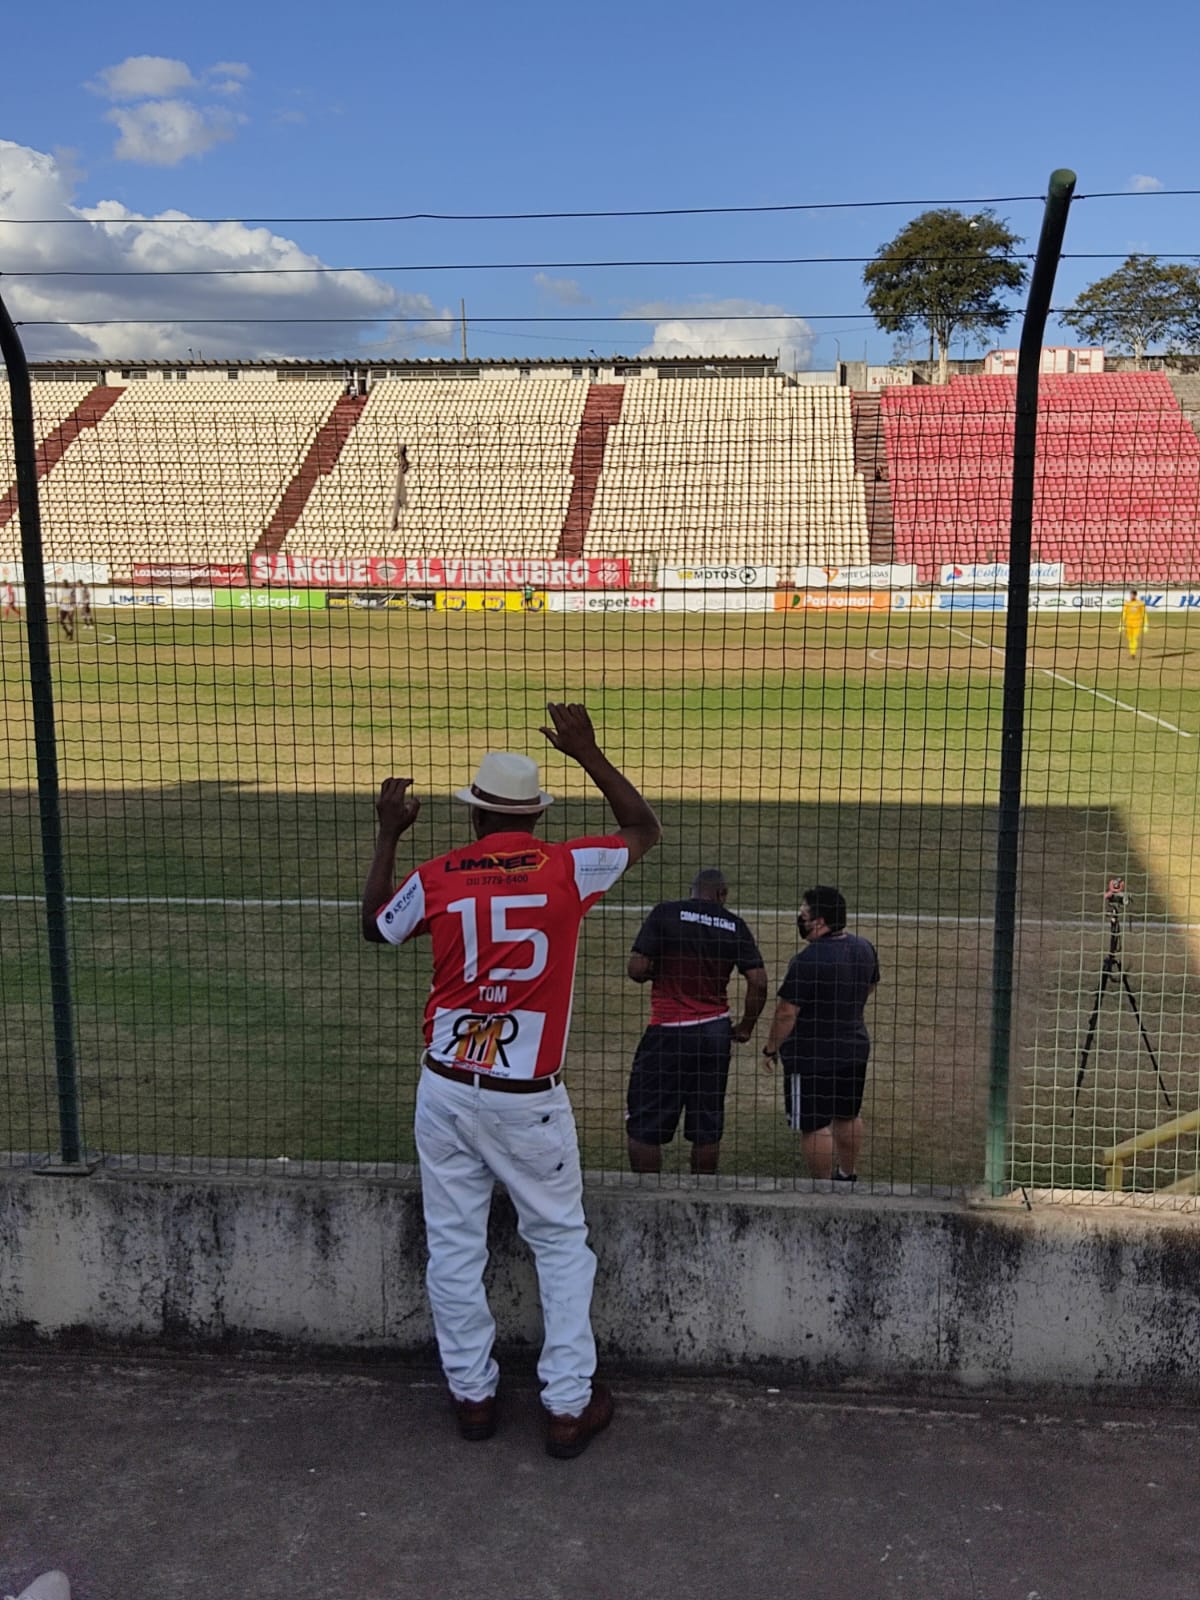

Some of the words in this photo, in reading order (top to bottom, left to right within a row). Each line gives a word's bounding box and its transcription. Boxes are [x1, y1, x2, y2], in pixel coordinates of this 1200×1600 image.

[254, 555, 372, 581] SANGUE
[401, 558, 590, 585] ALVIRRUBRO
[257, 595, 300, 606] Sicredi
[447, 894, 549, 983] 15
[478, 985, 507, 1003] TOM
